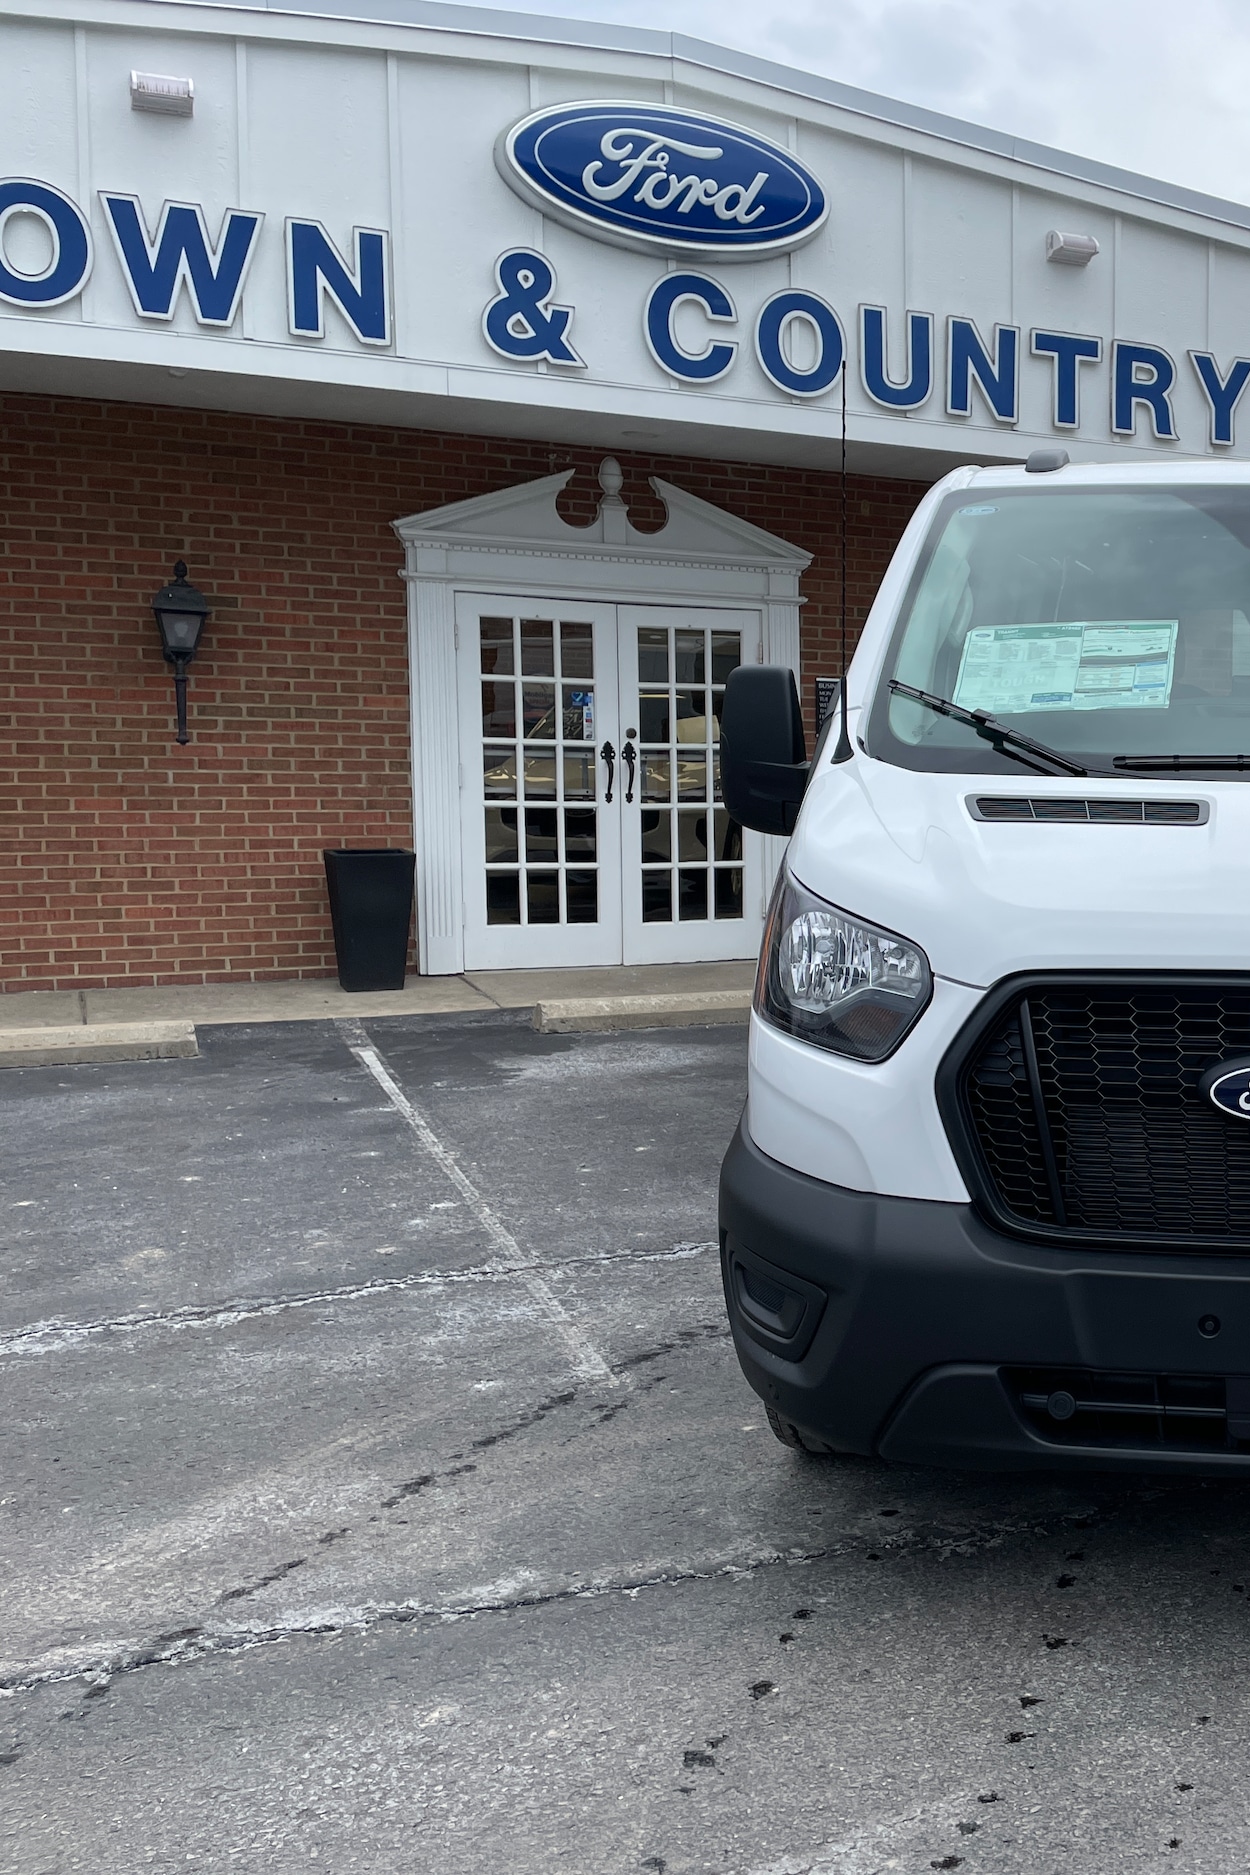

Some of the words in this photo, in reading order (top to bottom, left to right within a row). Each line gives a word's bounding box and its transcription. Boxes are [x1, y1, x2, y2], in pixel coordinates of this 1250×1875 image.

[582, 127, 771, 224] Ford
[483, 247, 586, 369] &
[991, 674, 1046, 689] TOUGH
